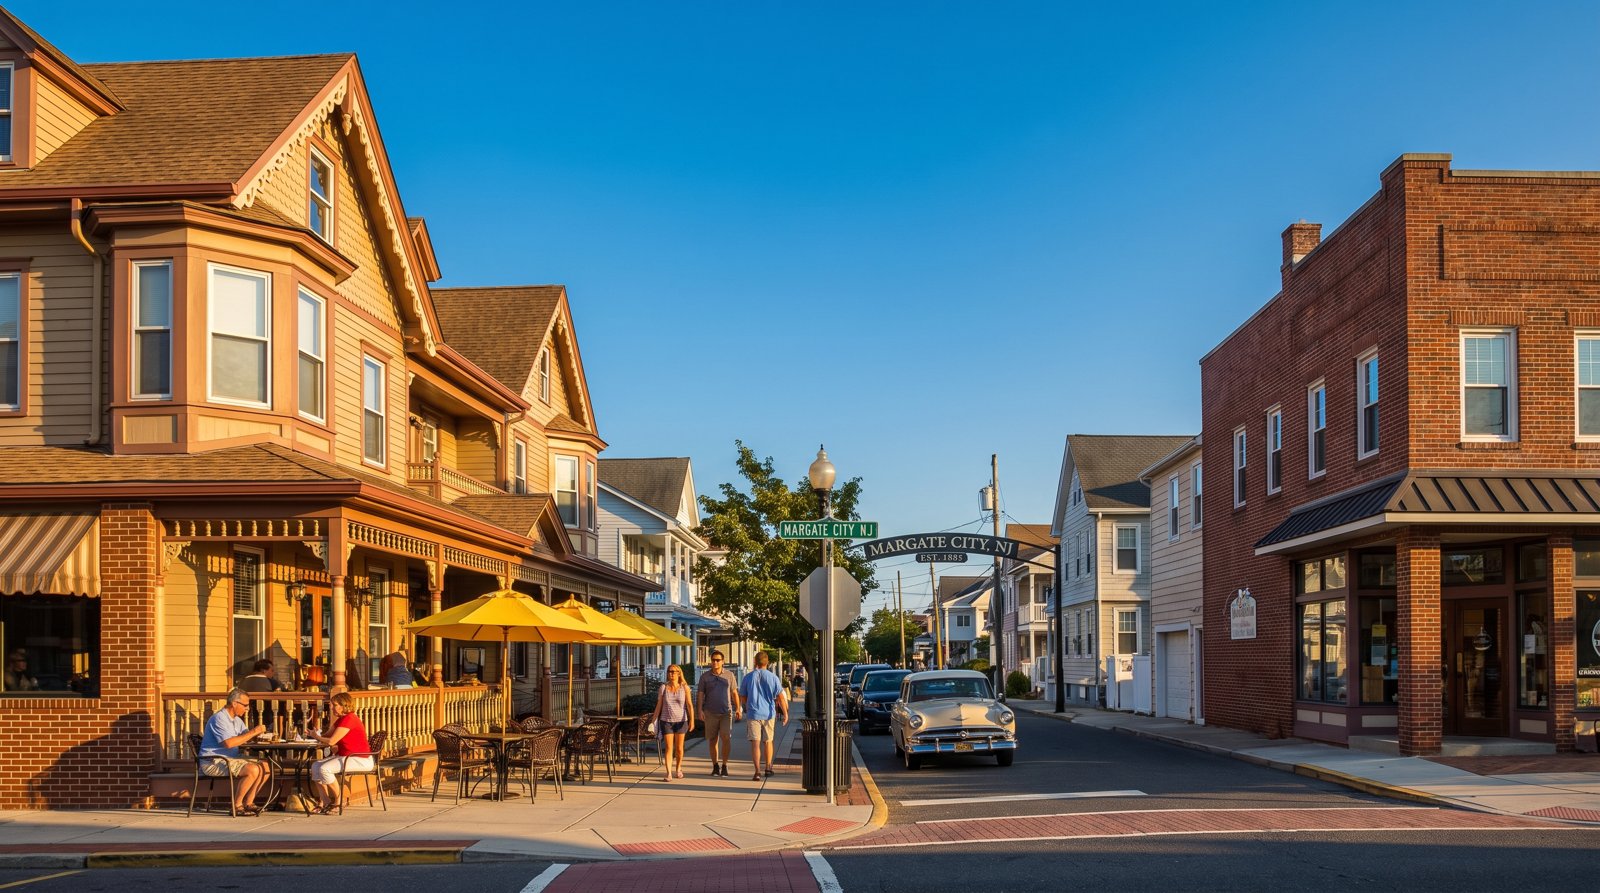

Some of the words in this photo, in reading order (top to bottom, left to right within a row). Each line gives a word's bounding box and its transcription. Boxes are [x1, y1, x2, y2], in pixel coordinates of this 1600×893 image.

[784, 524, 828, 536] MARGATE
[833, 524, 854, 536] CITY
[860, 524, 873, 536] NJ
[869, 536, 947, 557] MARGATE
[950, 536, 990, 552] CITY,
[994, 540, 1014, 556] NJ
[920, 554, 941, 562] EST.
[943, 554, 963, 562] 1885
